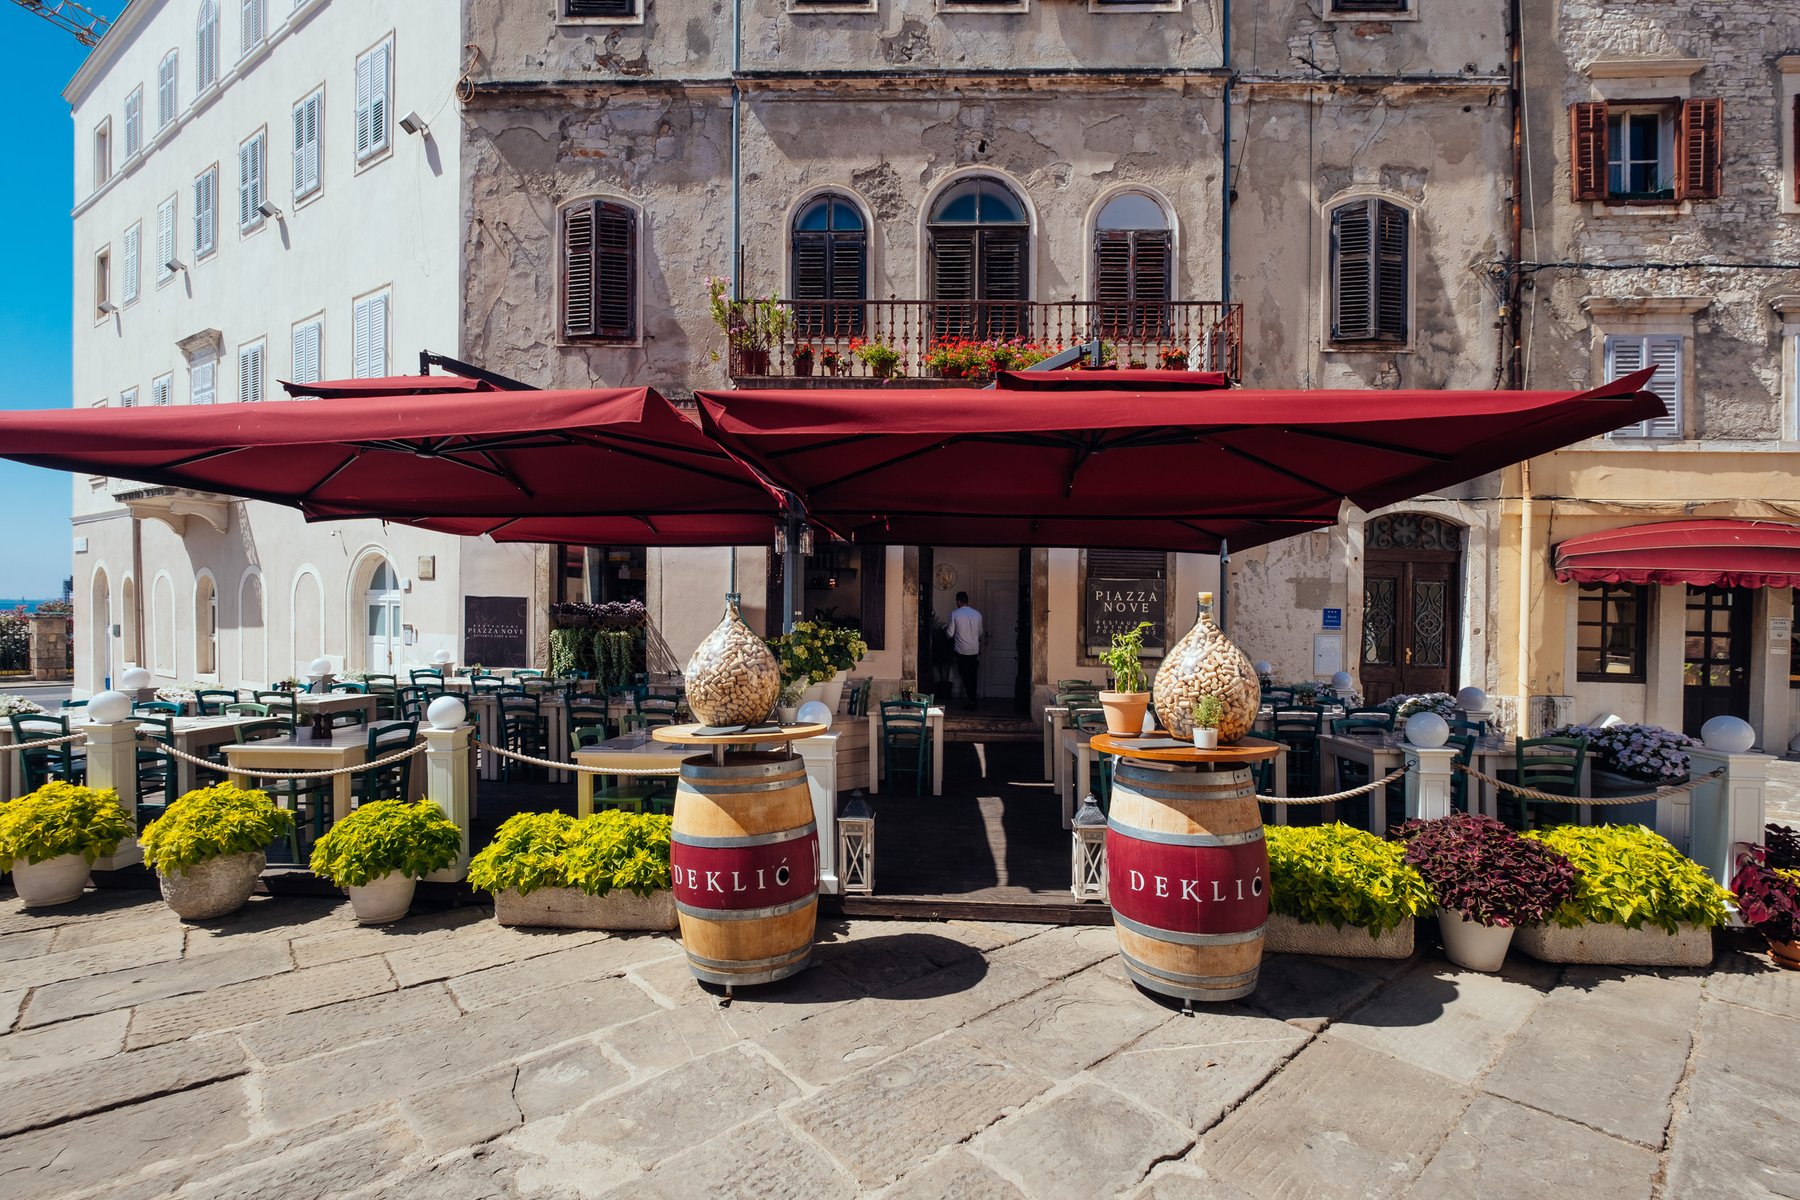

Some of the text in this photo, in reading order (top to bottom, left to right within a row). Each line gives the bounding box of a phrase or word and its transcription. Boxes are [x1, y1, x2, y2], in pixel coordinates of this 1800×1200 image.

[1095, 591, 1157, 602] PIAZZA
[1104, 602, 1149, 613] NOVE
[673, 857, 790, 893] DEKLIĆ
[1129, 867, 1262, 903] DEKLIĆ
